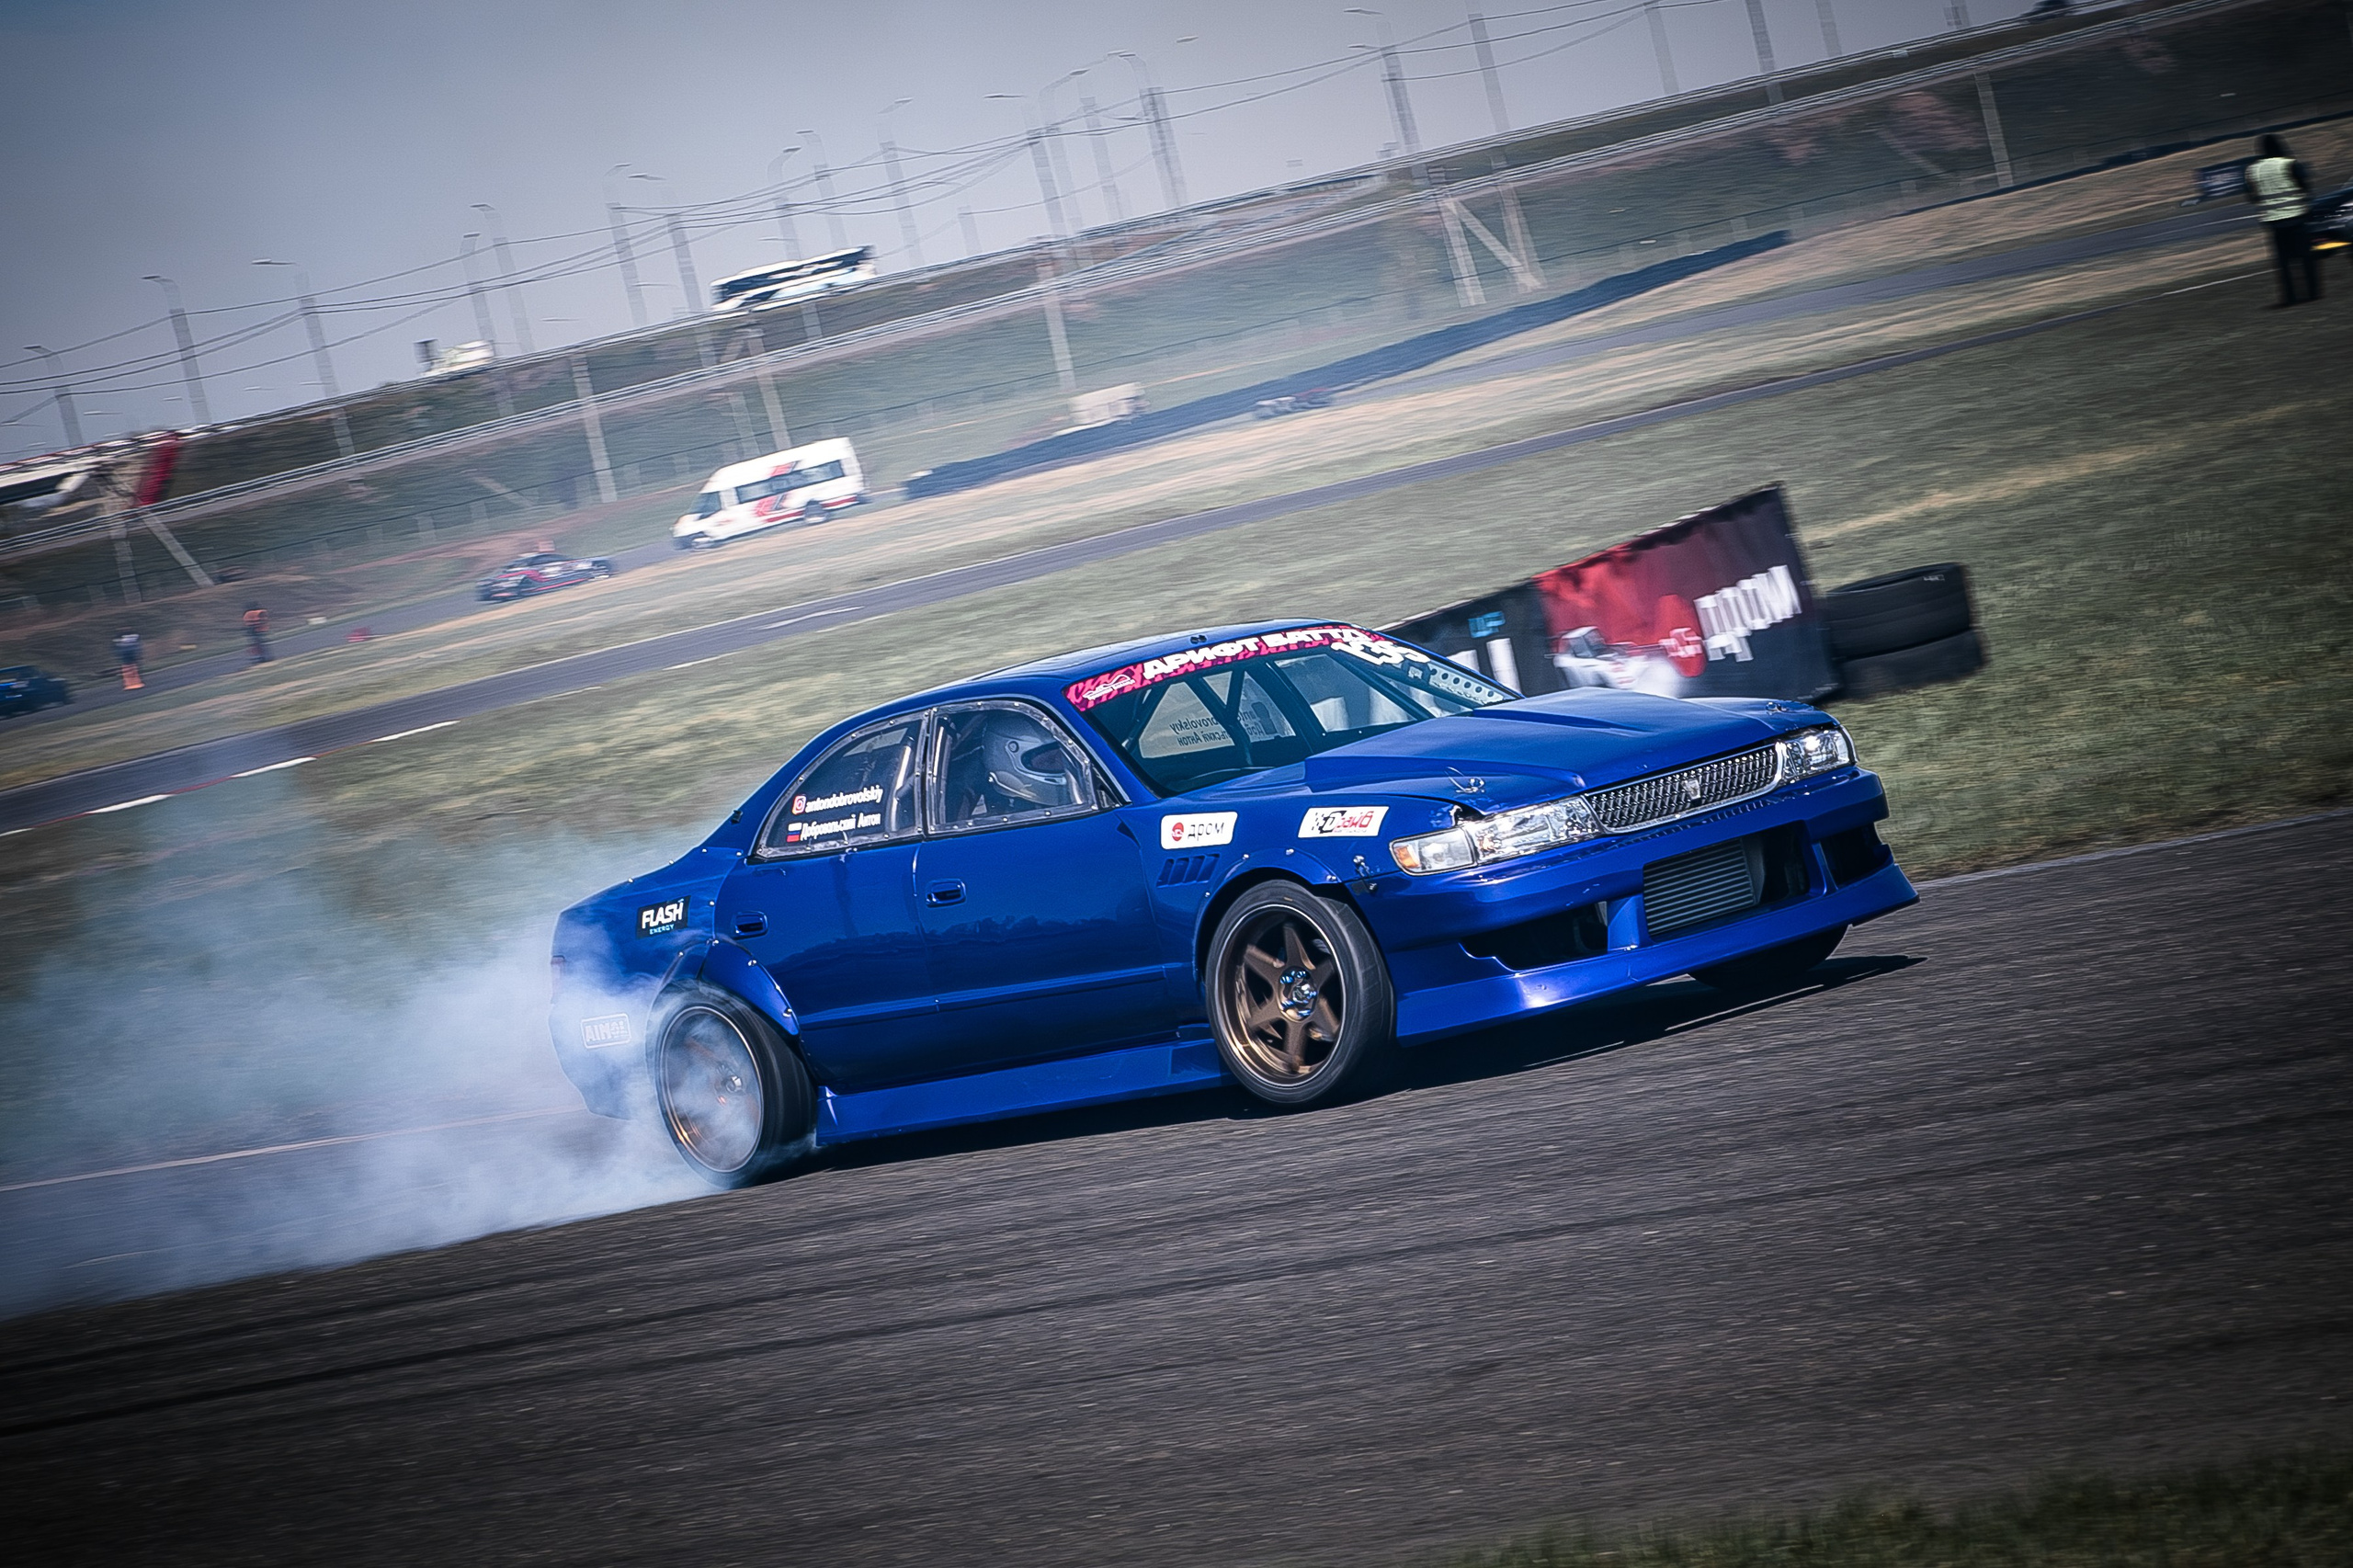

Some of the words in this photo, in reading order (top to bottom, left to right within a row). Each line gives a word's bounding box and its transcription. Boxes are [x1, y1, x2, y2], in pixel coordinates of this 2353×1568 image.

[1188, 822, 1224, 841] дром
[642, 902, 684, 929] FLASH
[649, 924, 675, 935] ENERGY
